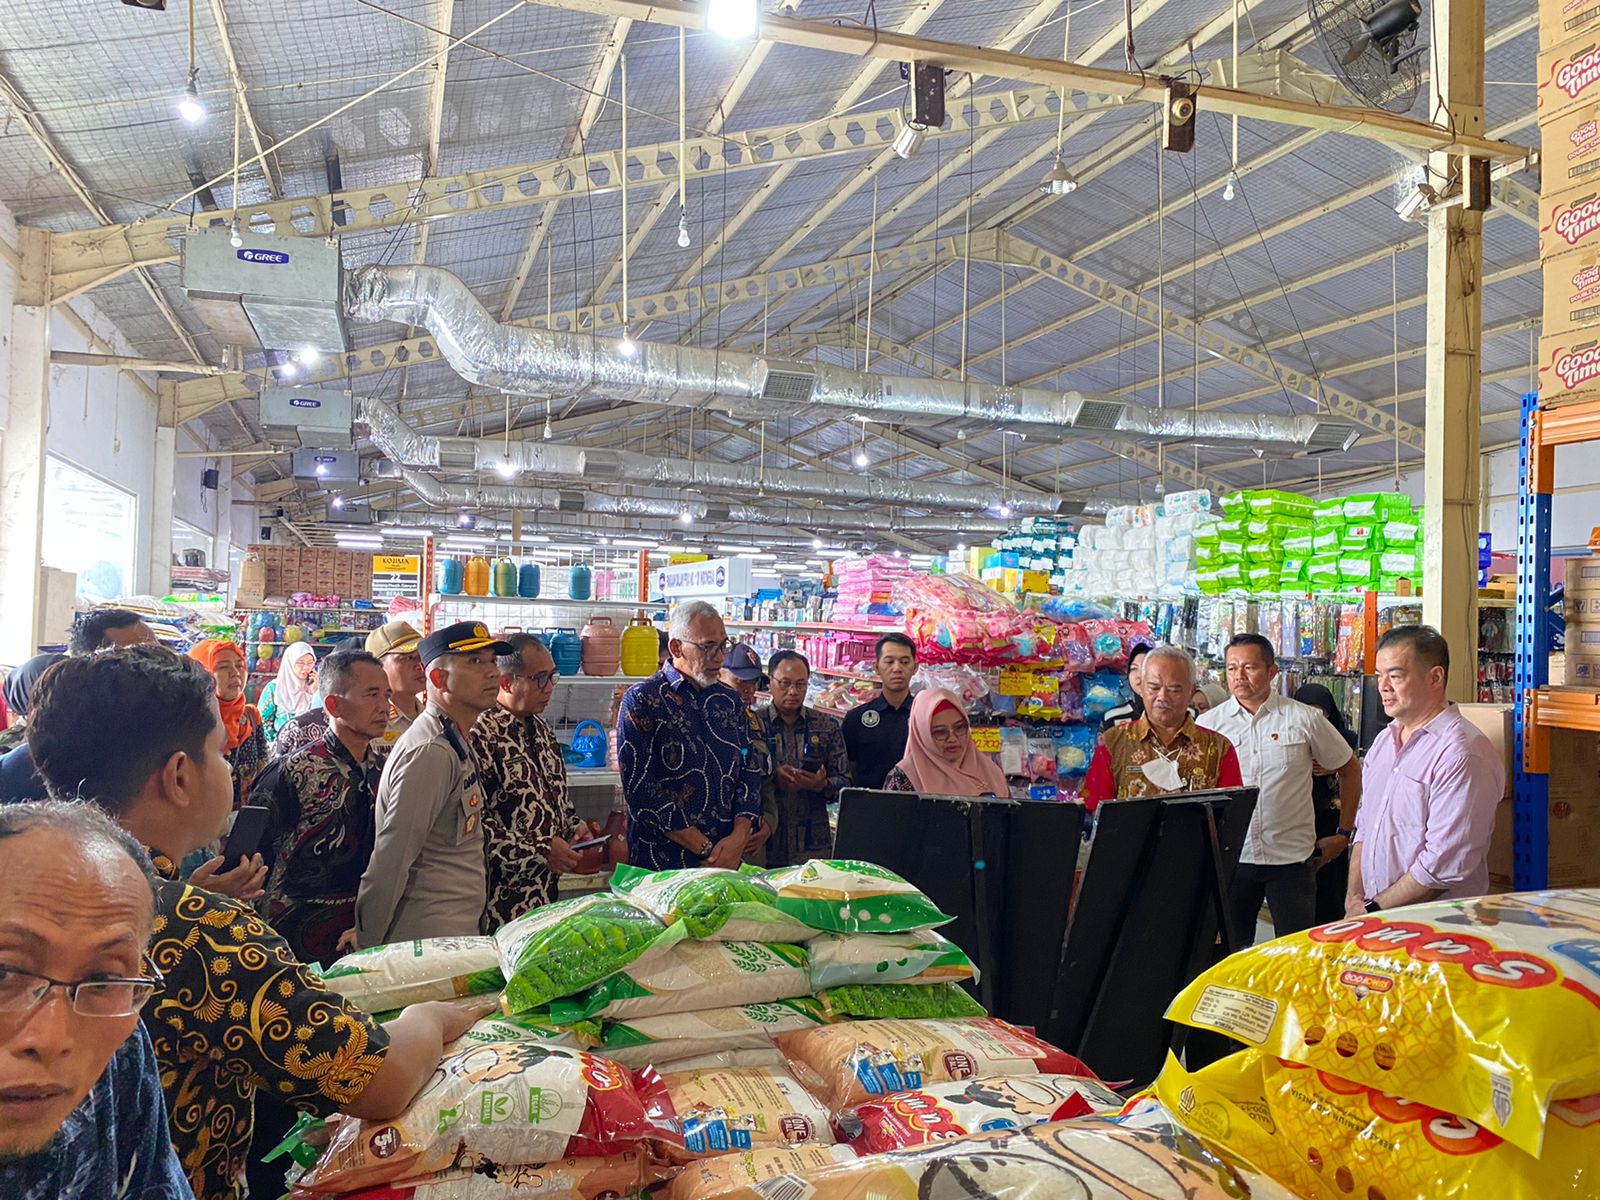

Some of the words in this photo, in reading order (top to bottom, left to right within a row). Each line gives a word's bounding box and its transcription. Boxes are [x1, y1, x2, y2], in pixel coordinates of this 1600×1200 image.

[1571, 120, 1596, 141] Good
[1575, 130, 1596, 146] Time
[254, 253, 283, 262] GREE
[1573, 266, 1598, 284] Good
[1577, 275, 1599, 290] Time
[1324, 920, 1546, 980] Sumo
